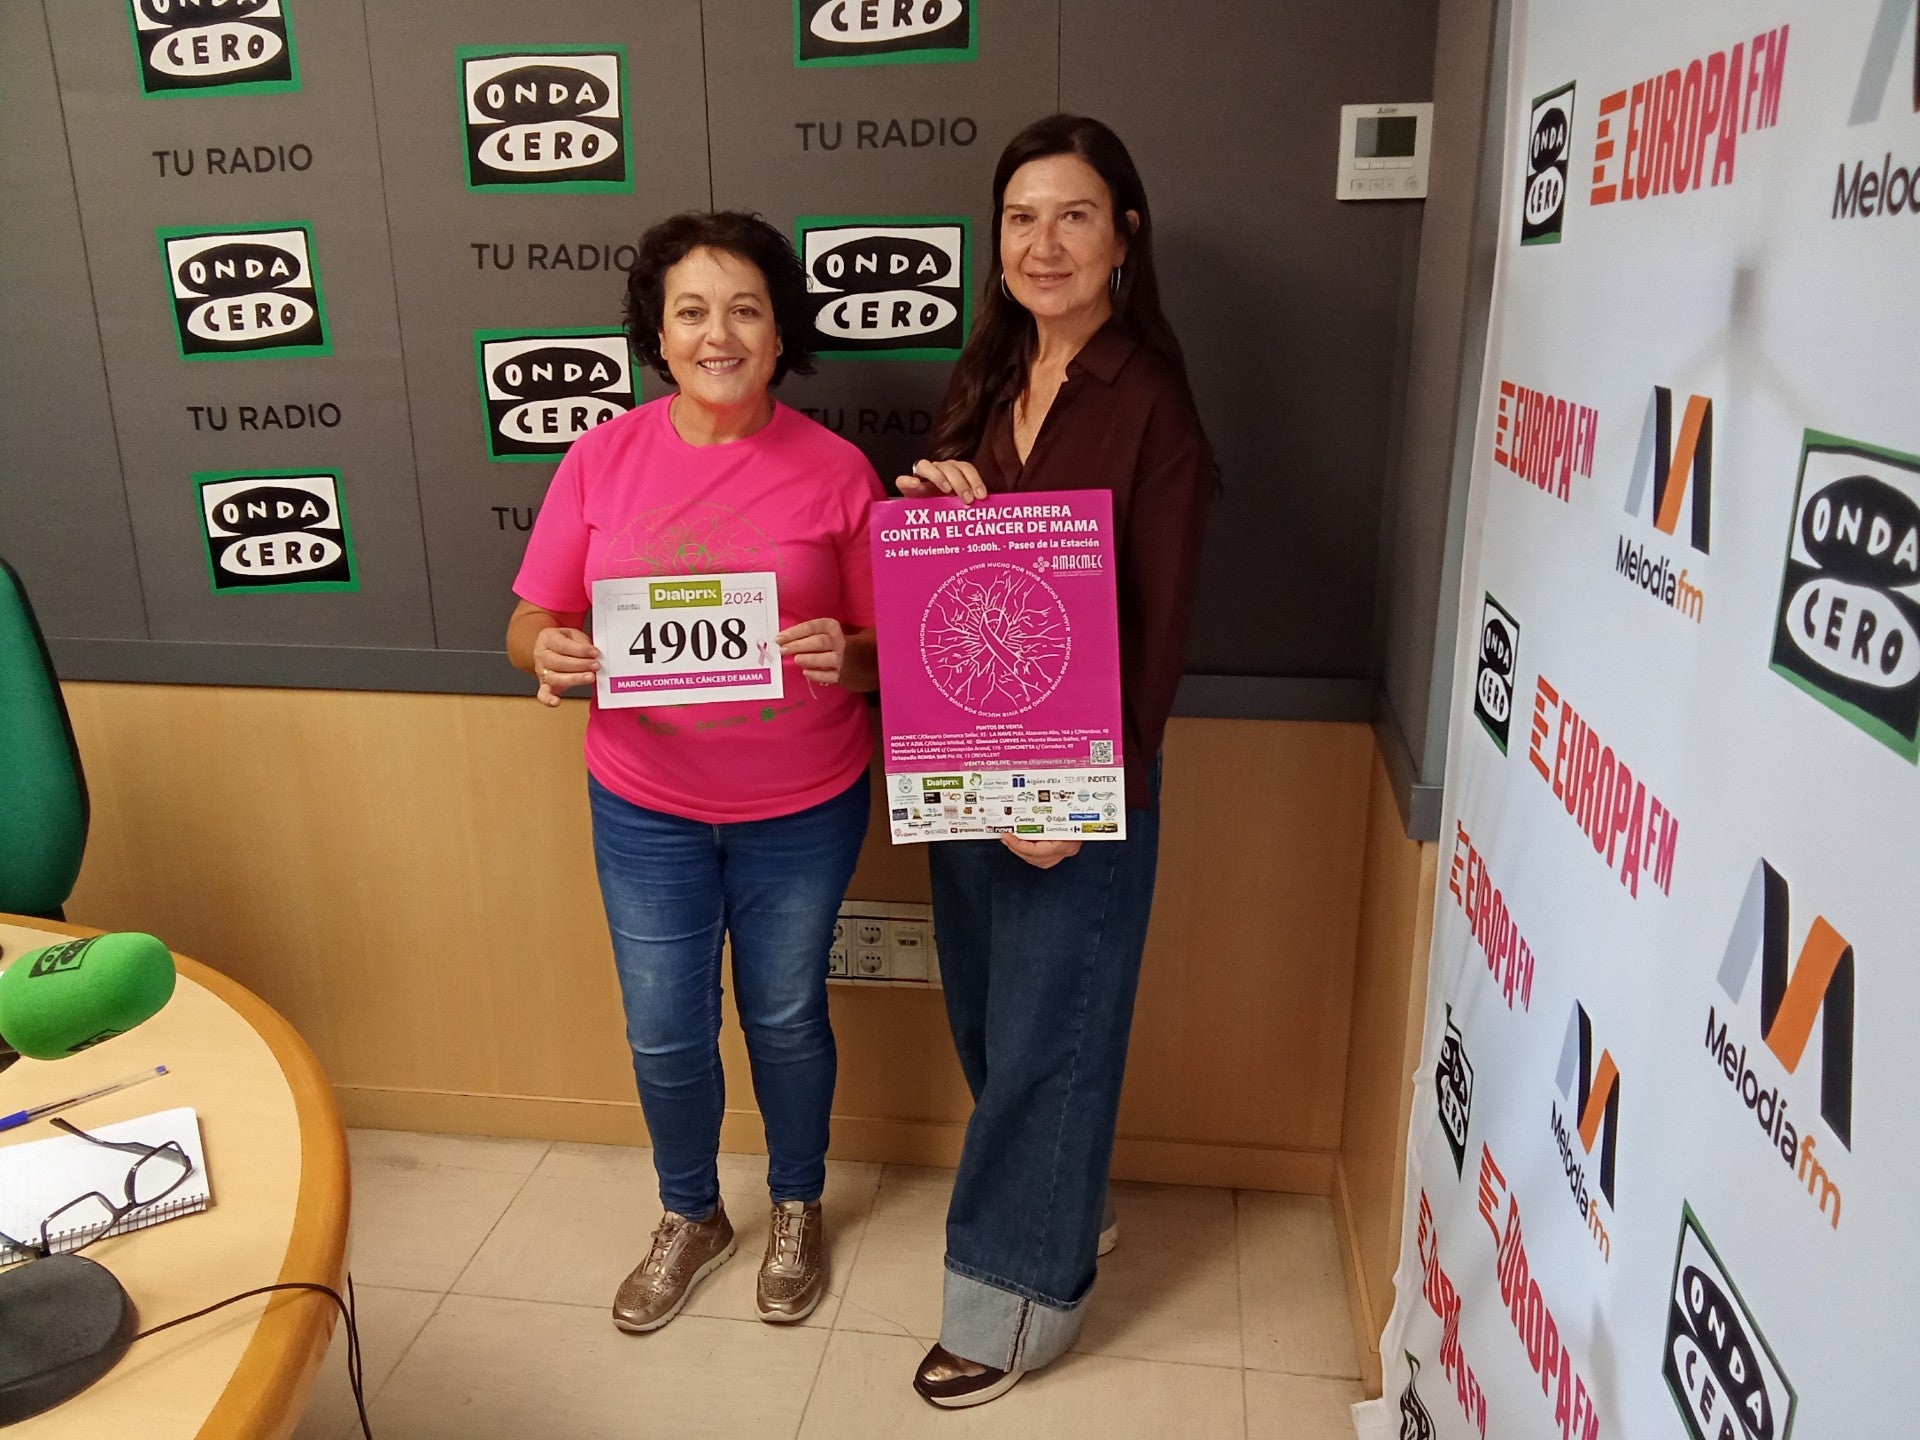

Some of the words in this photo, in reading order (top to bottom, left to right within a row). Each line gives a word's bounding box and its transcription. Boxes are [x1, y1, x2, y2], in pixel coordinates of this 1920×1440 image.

[831, 0, 942, 32] CERO
[167, 33, 265, 66] CERO
[486, 82, 598, 109] ONDA
[1620, 42, 1744, 201] EUROPA
[1741, 24, 1790, 134] FM
[496, 132, 601, 162] CERO
[795, 122, 842, 151] TU
[857, 117, 978, 149] RADIO
[1532, 122, 1563, 158] ONDA
[153, 150, 194, 178] TU
[207, 144, 313, 175] RADIO
[1530, 175, 1560, 214] CERO
[189, 257, 290, 285] ONDA
[471, 243, 514, 270] TU
[528, 243, 639, 272] RADIO
[826, 252, 938, 279] ONDA
[203, 303, 297, 333] CERO
[833, 302, 939, 329] CERO
[505, 362, 609, 386] ONDA
[186, 406, 227, 431] TU
[241, 402, 341, 430] RADIO
[858, 408, 932, 435] RAD
[1509, 386, 1576, 503] EUROPA
[1573, 405, 1598, 479] FM
[222, 498, 319, 524] ONDA
[491, 506, 532, 531] TU
[904, 509, 930, 525] XX
[934, 505, 1072, 524] MARCHA/CARRERA
[880, 527, 940, 542] CONTRA
[946, 526, 963, 538] EL
[965, 521, 1024, 537] CÁNCER
[1027, 521, 1047, 533] DE
[1050, 519, 1099, 533] MAMA
[1812, 498, 1919, 572] ONDA
[235, 538, 325, 568] CERO
[885, 549, 896, 558] 24
[898, 548, 909, 557] de
[911, 545, 960, 556] Noviembre
[967, 542, 1001, 553] 10:00h.
[1008, 541, 1035, 550] Paseo
[1036, 539, 1048, 548] de
[1049, 539, 1059, 548] la
[1060, 538, 1100, 548] Estación
[1051, 554, 1103, 570] AMACMEC
[654, 587, 718, 604] Dialprix
[724, 591, 764, 605] 2024
[628, 618, 748, 664] 4908
[1803, 588, 1904, 675] CERO
[1485, 627, 1510, 668] ONDA
[618, 680, 651, 689] MARCHA
[653, 679, 684, 687] CONTRA
[696, 675, 726, 684] CÁNCER
[739, 673, 764, 682] MAMA
[1482, 673, 1505, 716] CERO
[1087, 775, 1117, 783] INDITEX
[1553, 699, 1646, 900] EUROPA
[1643, 795, 1679, 897] FM
[1690, 1275, 1763, 1430] ONDA
